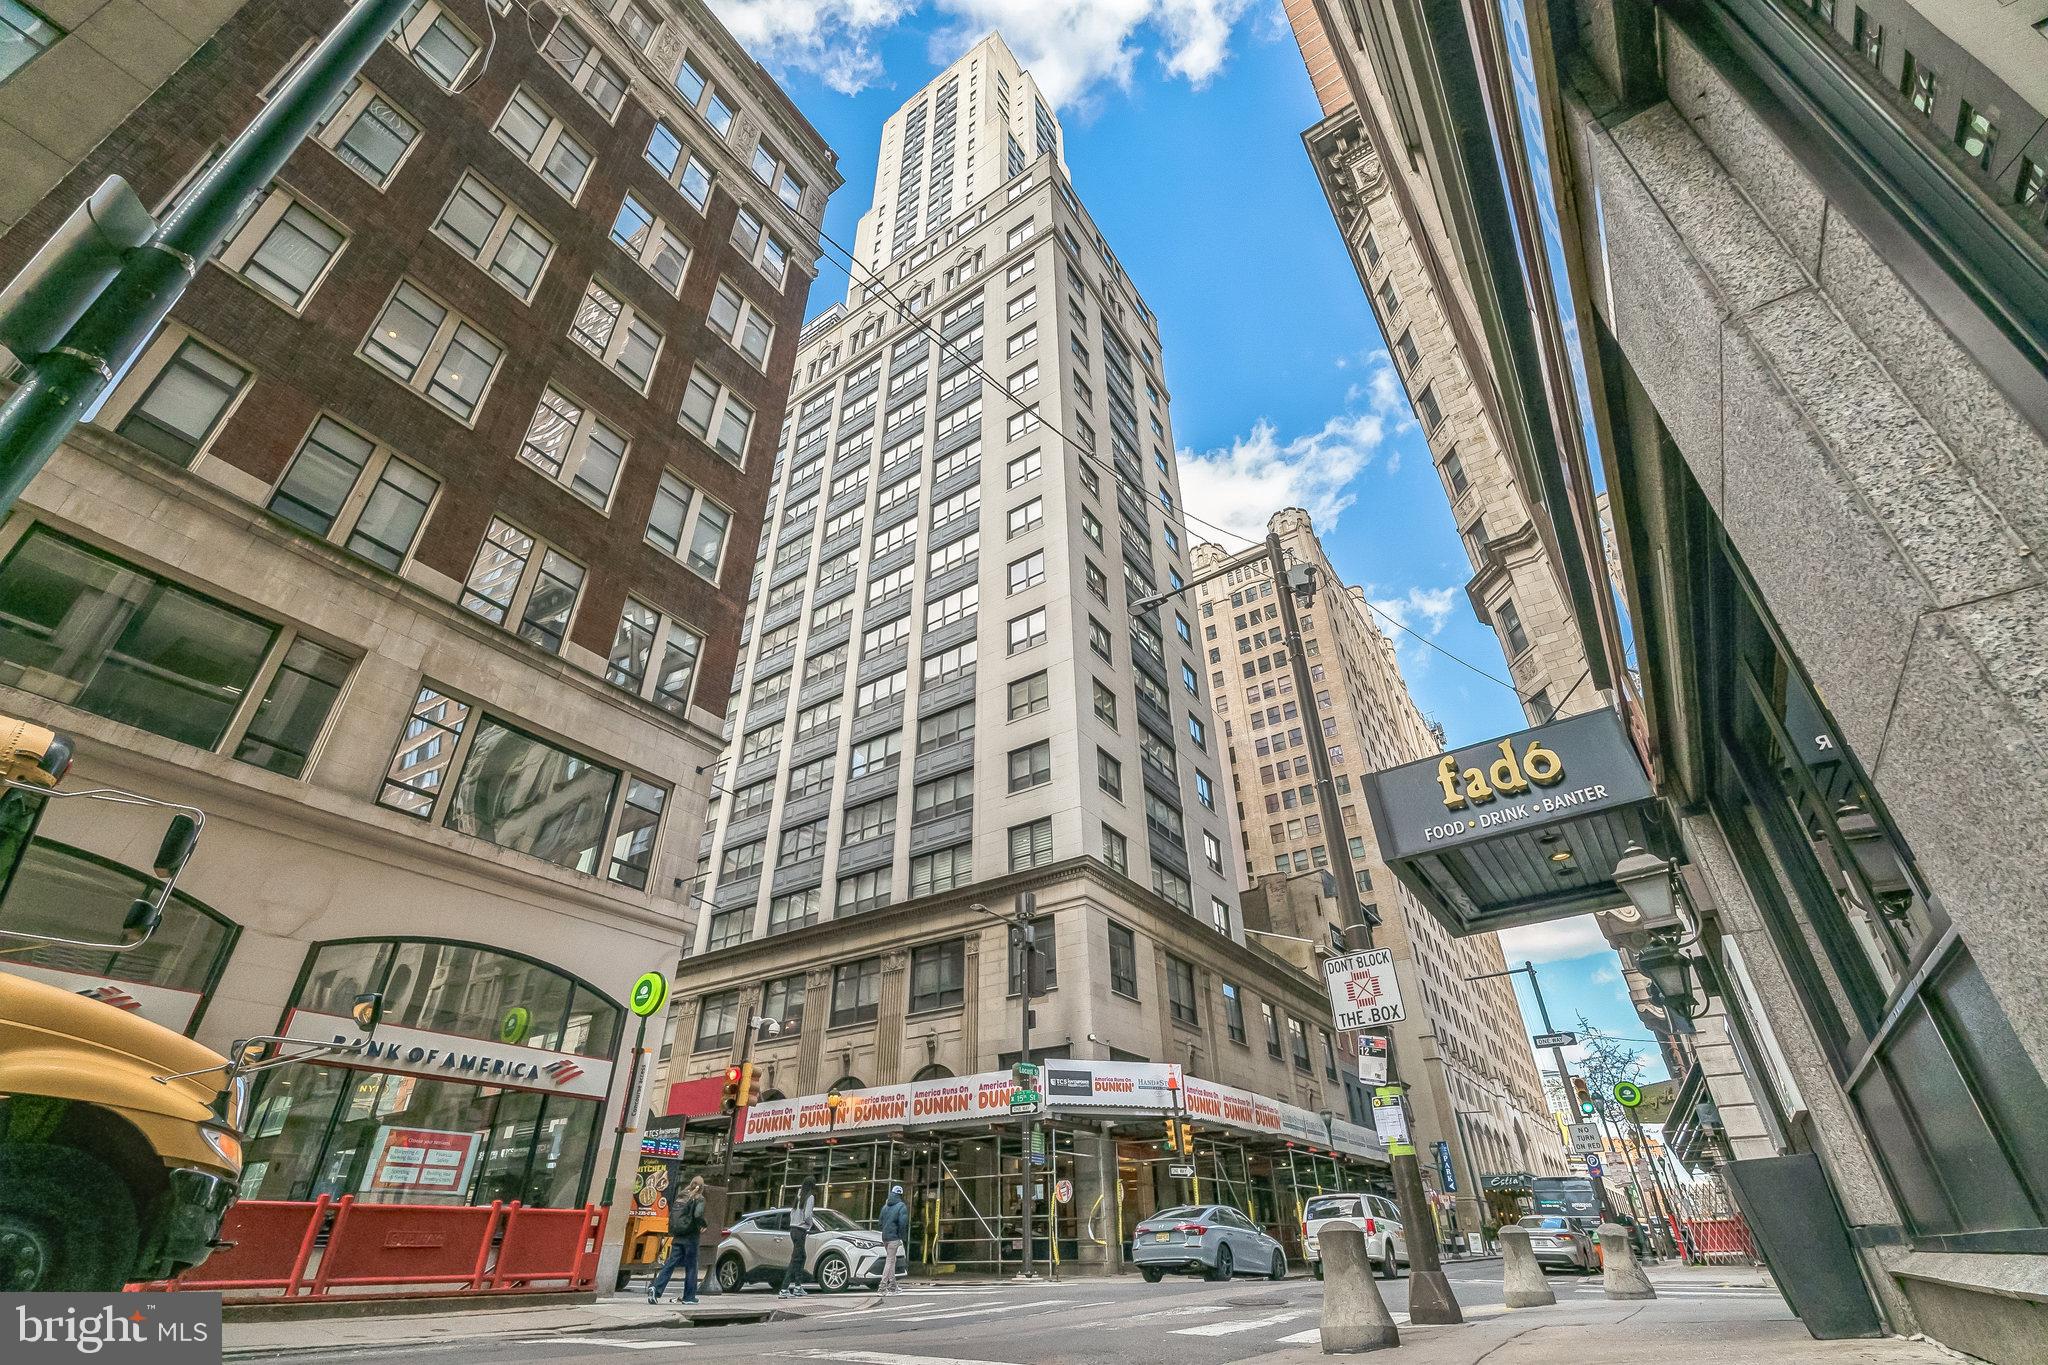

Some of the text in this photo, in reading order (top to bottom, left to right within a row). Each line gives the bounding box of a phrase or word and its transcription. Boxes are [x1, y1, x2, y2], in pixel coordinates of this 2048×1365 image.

[1437, 738, 1564, 808] fadó
[1424, 784, 1609, 842] FOOD DRINK BANTER
[1356, 951, 1390, 969] BLOCK
[1339, 1004, 1401, 1028] THE BOX
[333, 1035, 539, 1080] BANK OF AMERICA
[1360, 1047, 1370, 1056] 12
[631, 1064, 647, 1117] Concourse access
[914, 1085, 969, 1099] America Runs On
[978, 1081, 1007, 1091] America
[1094, 1081, 1135, 1093] DUNKIN'
[880, 1095, 895, 1103] Runs
[896, 1093, 905, 1101] On
[913, 1094, 973, 1116] DUNKIN'
[1029, 1092, 1036, 1101] St
[750, 1107, 793, 1119] America Runs On
[800, 1103, 824, 1112] America
[854, 1100, 909, 1122] DUNKIN'
[747, 1114, 796, 1135] DUNKIN'
[1443, 1155, 1453, 1182] PARK
